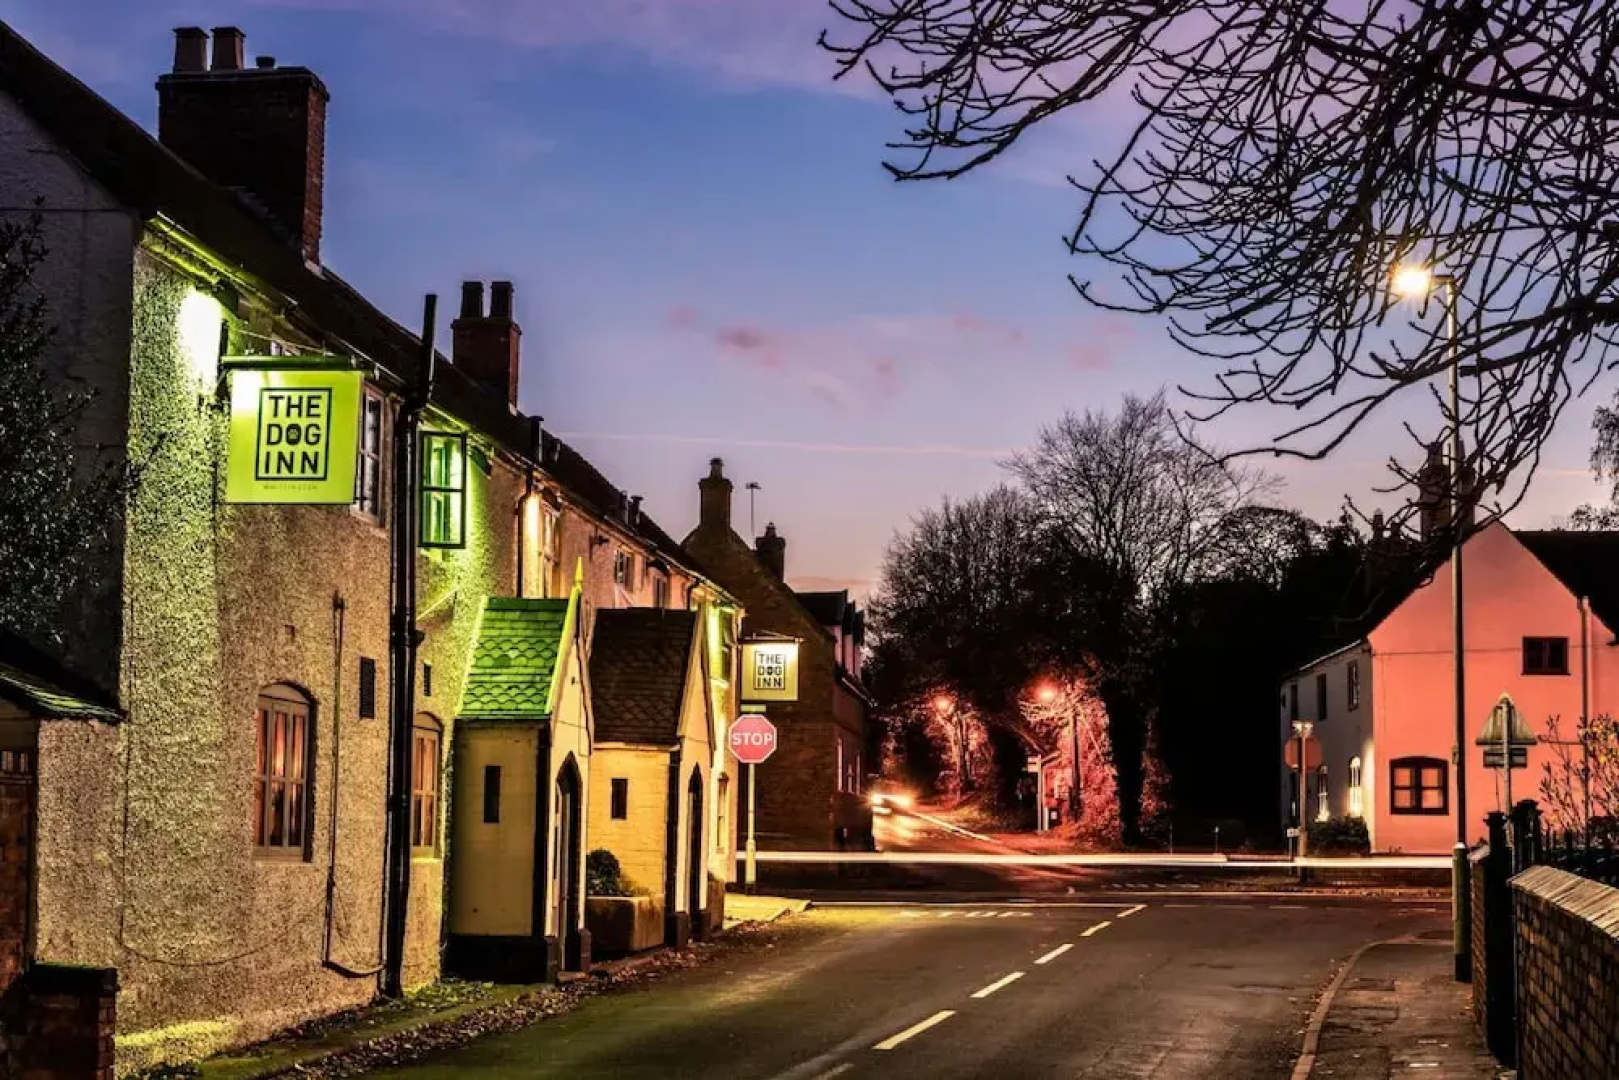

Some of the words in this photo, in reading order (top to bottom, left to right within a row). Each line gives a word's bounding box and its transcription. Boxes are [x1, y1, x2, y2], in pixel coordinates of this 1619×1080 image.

[268, 395, 322, 418] THE
[266, 423, 322, 446] DOG
[264, 451, 320, 474] INN
[758, 653, 783, 664] THE
[757, 666, 782, 676] DOG
[757, 677, 782, 687] INN
[732, 732, 773, 746] STOP
